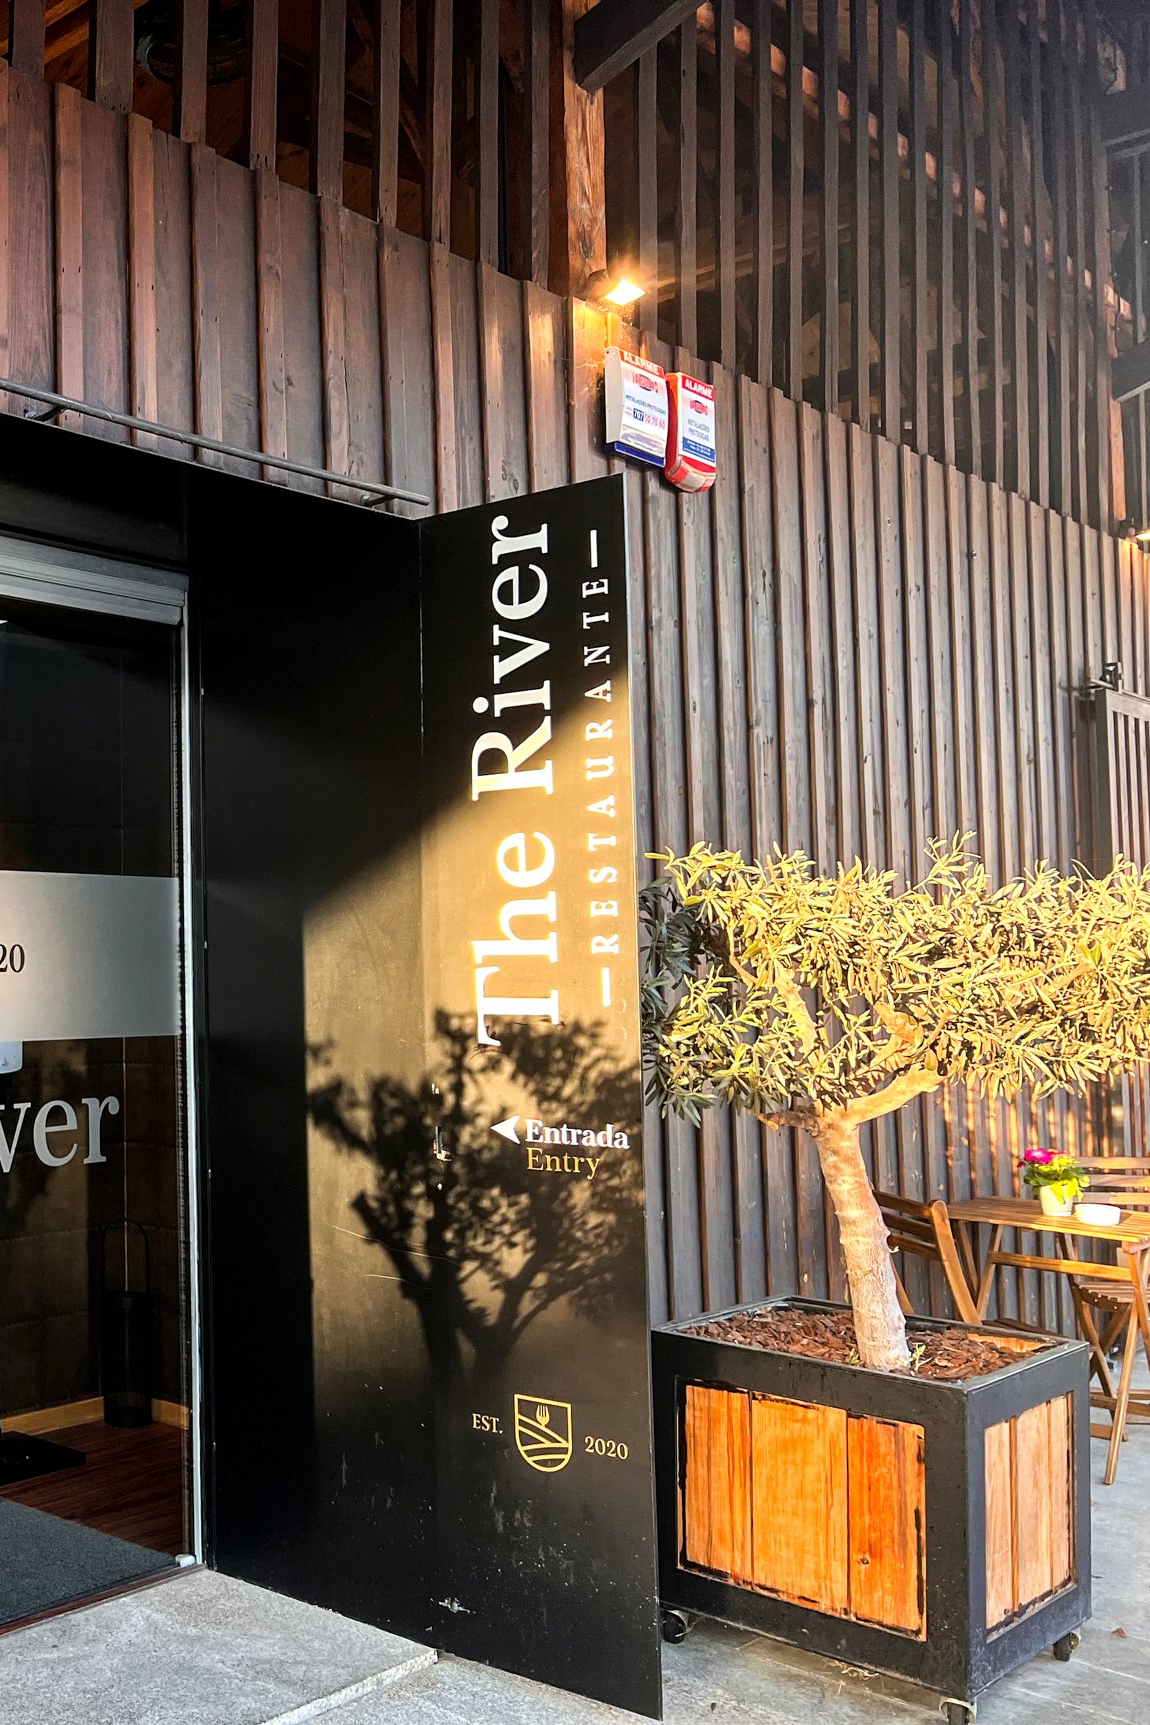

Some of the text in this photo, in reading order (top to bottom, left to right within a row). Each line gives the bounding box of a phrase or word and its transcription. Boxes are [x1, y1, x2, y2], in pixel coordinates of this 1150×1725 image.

[623, 351, 660, 376] ALARME
[684, 378, 713, 399] ALARME
[633, 409, 644, 421] 707
[471, 513, 559, 1047] The River
[582, 576, 618, 955] RESTAURANTE
[524, 1118, 631, 1150] Entrada
[526, 1147, 601, 1180] Entry
[471, 1412, 629, 1460] EST. 2020
